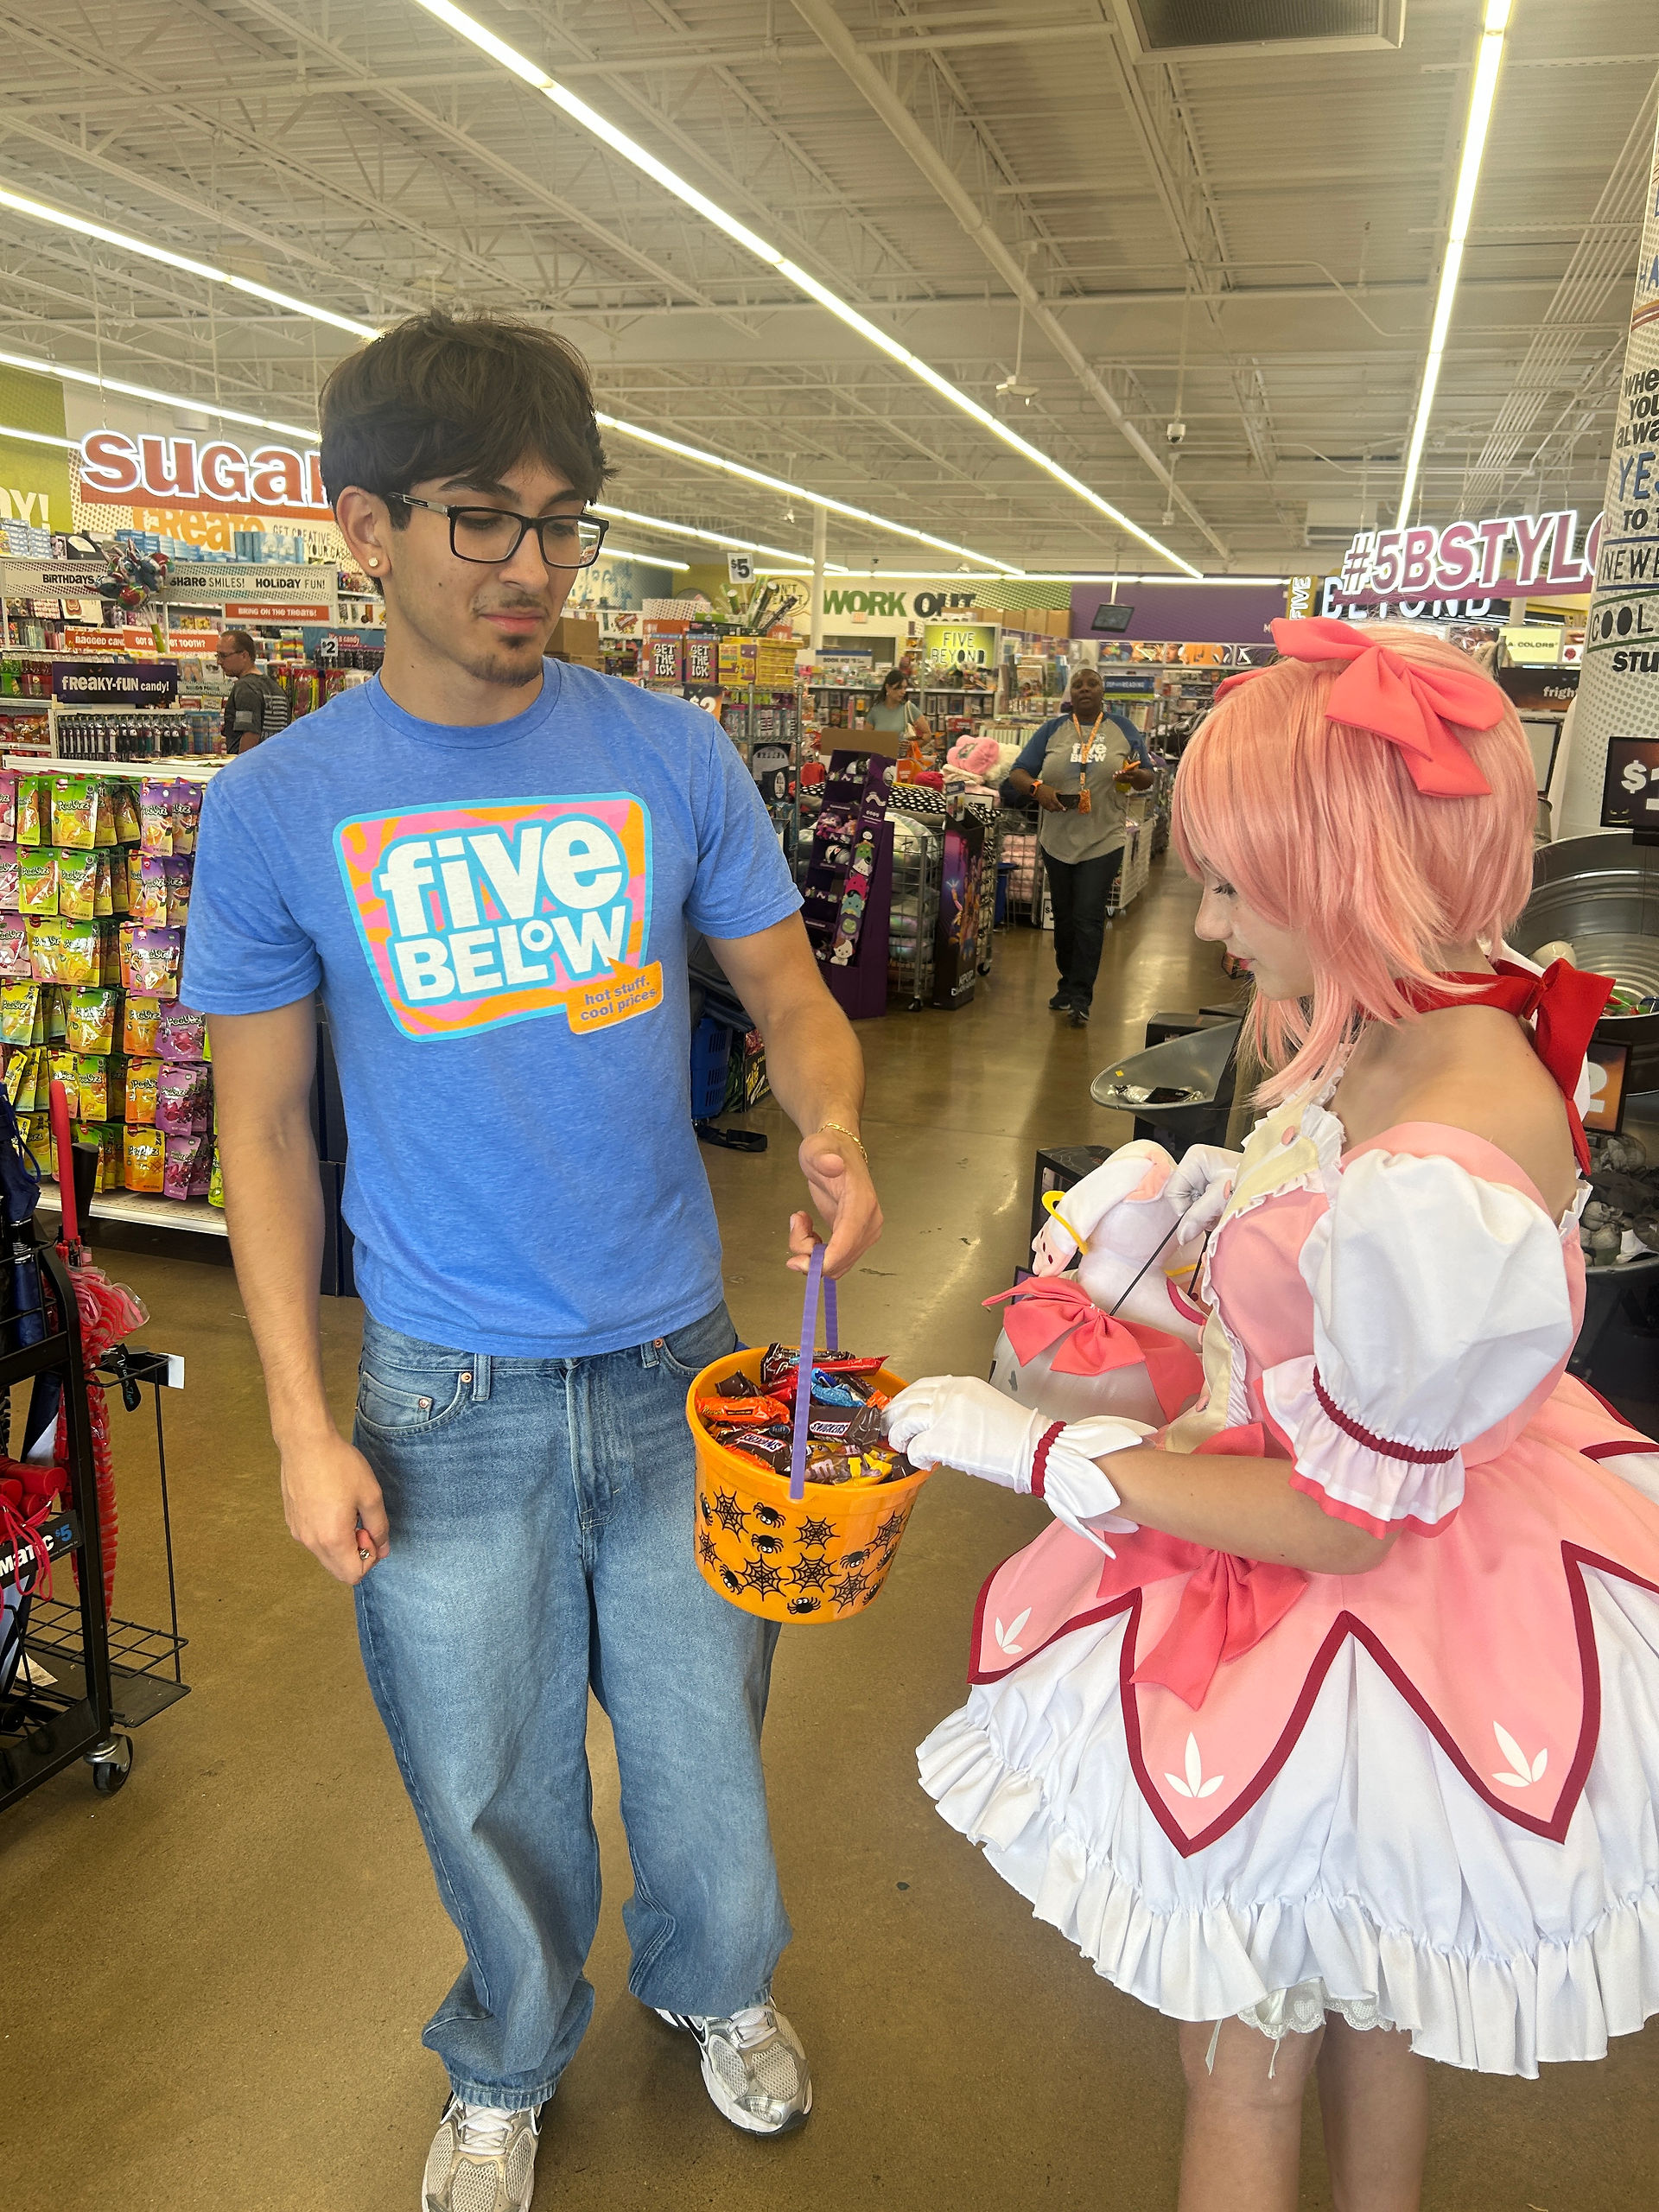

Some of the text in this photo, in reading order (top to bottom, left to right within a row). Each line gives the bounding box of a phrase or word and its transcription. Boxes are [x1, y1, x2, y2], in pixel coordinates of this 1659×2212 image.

[1618, 451, 1659, 502] YE
[1623, 508, 1648, 531] TO
[731, 558, 750, 579] $5
[208, 576, 245, 588] SMILES!
[304, 579, 326, 589] FUN!
[823, 589, 907, 618] WORK
[1289, 575, 1311, 620] FIVE
[1592, 604, 1654, 642] COOL
[178, 639, 206, 648] TOOTH?
[321, 641, 336, 654] $2
[943, 632, 975, 648] FIVE
[654, 643, 677, 655] GET
[690, 644, 710, 656] GET
[931, 648, 985, 665] BEYOND
[654, 653, 677, 665] THE
[690, 655, 710, 666] THE
[655, 664, 677, 677] ICK
[691, 664, 710, 677] ICK
[141, 680, 169, 694] candy!
[1543, 685, 1576, 700] frigh
[1071, 742, 1107, 755] fve
[378, 820, 623, 938] five
[394, 905, 627, 1001] BELOW
[584, 975, 651, 1006] hot stuff.
[580, 1001, 614, 1021] cool
[810, 1421, 849, 1435] SNICKERS
[54, 1522, 73, 1542] $5
